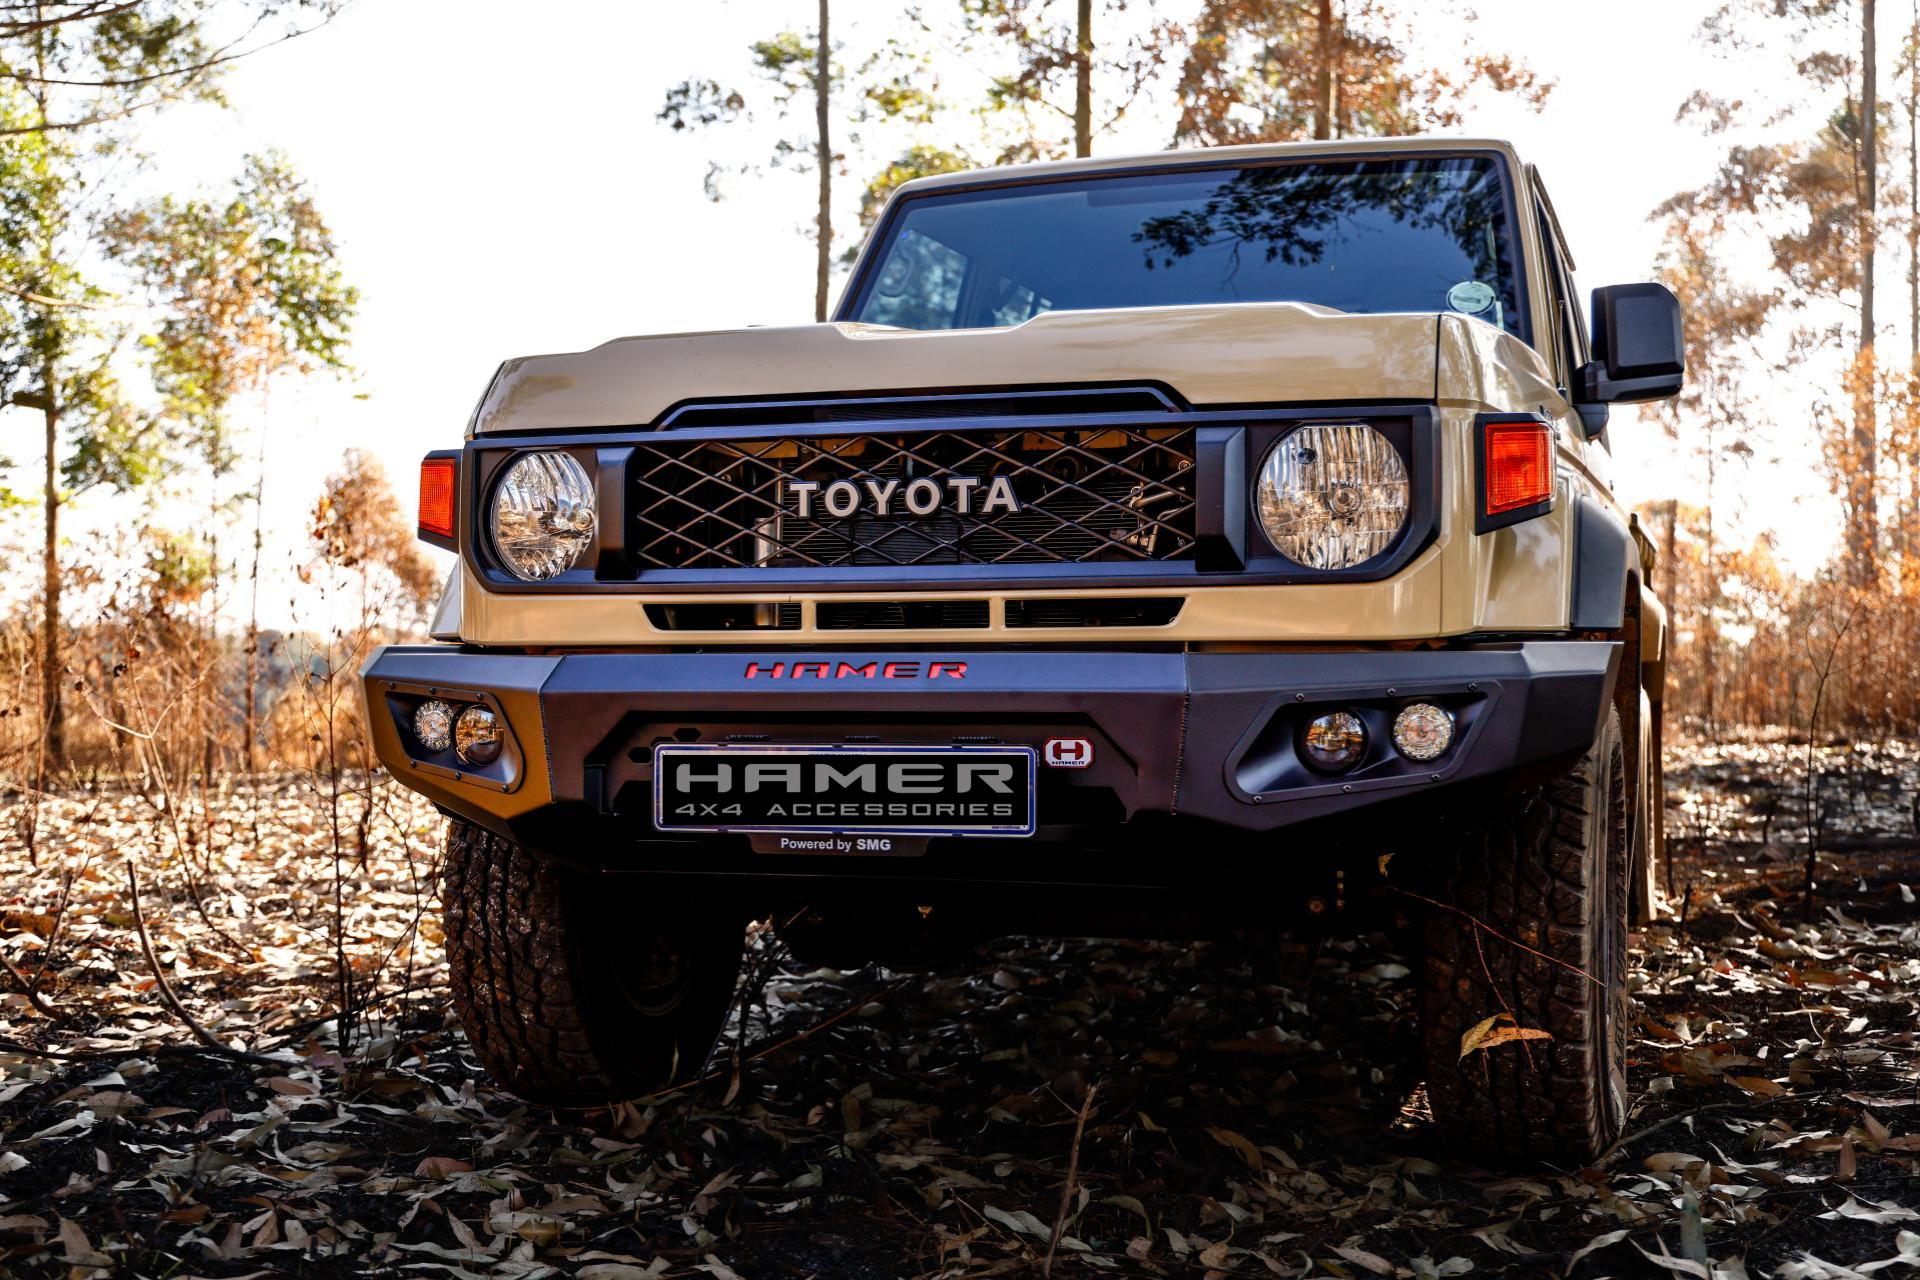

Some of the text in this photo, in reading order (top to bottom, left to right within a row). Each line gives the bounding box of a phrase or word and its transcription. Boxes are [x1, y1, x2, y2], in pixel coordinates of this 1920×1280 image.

[789, 475, 1021, 518] TOYOTA
[744, 661, 969, 679] HAMER
[675, 763, 1015, 793] HAMER
[675, 803, 1013, 816] 4X4 ACCESSORIES
[781, 837, 892, 853] Powered by SMG
